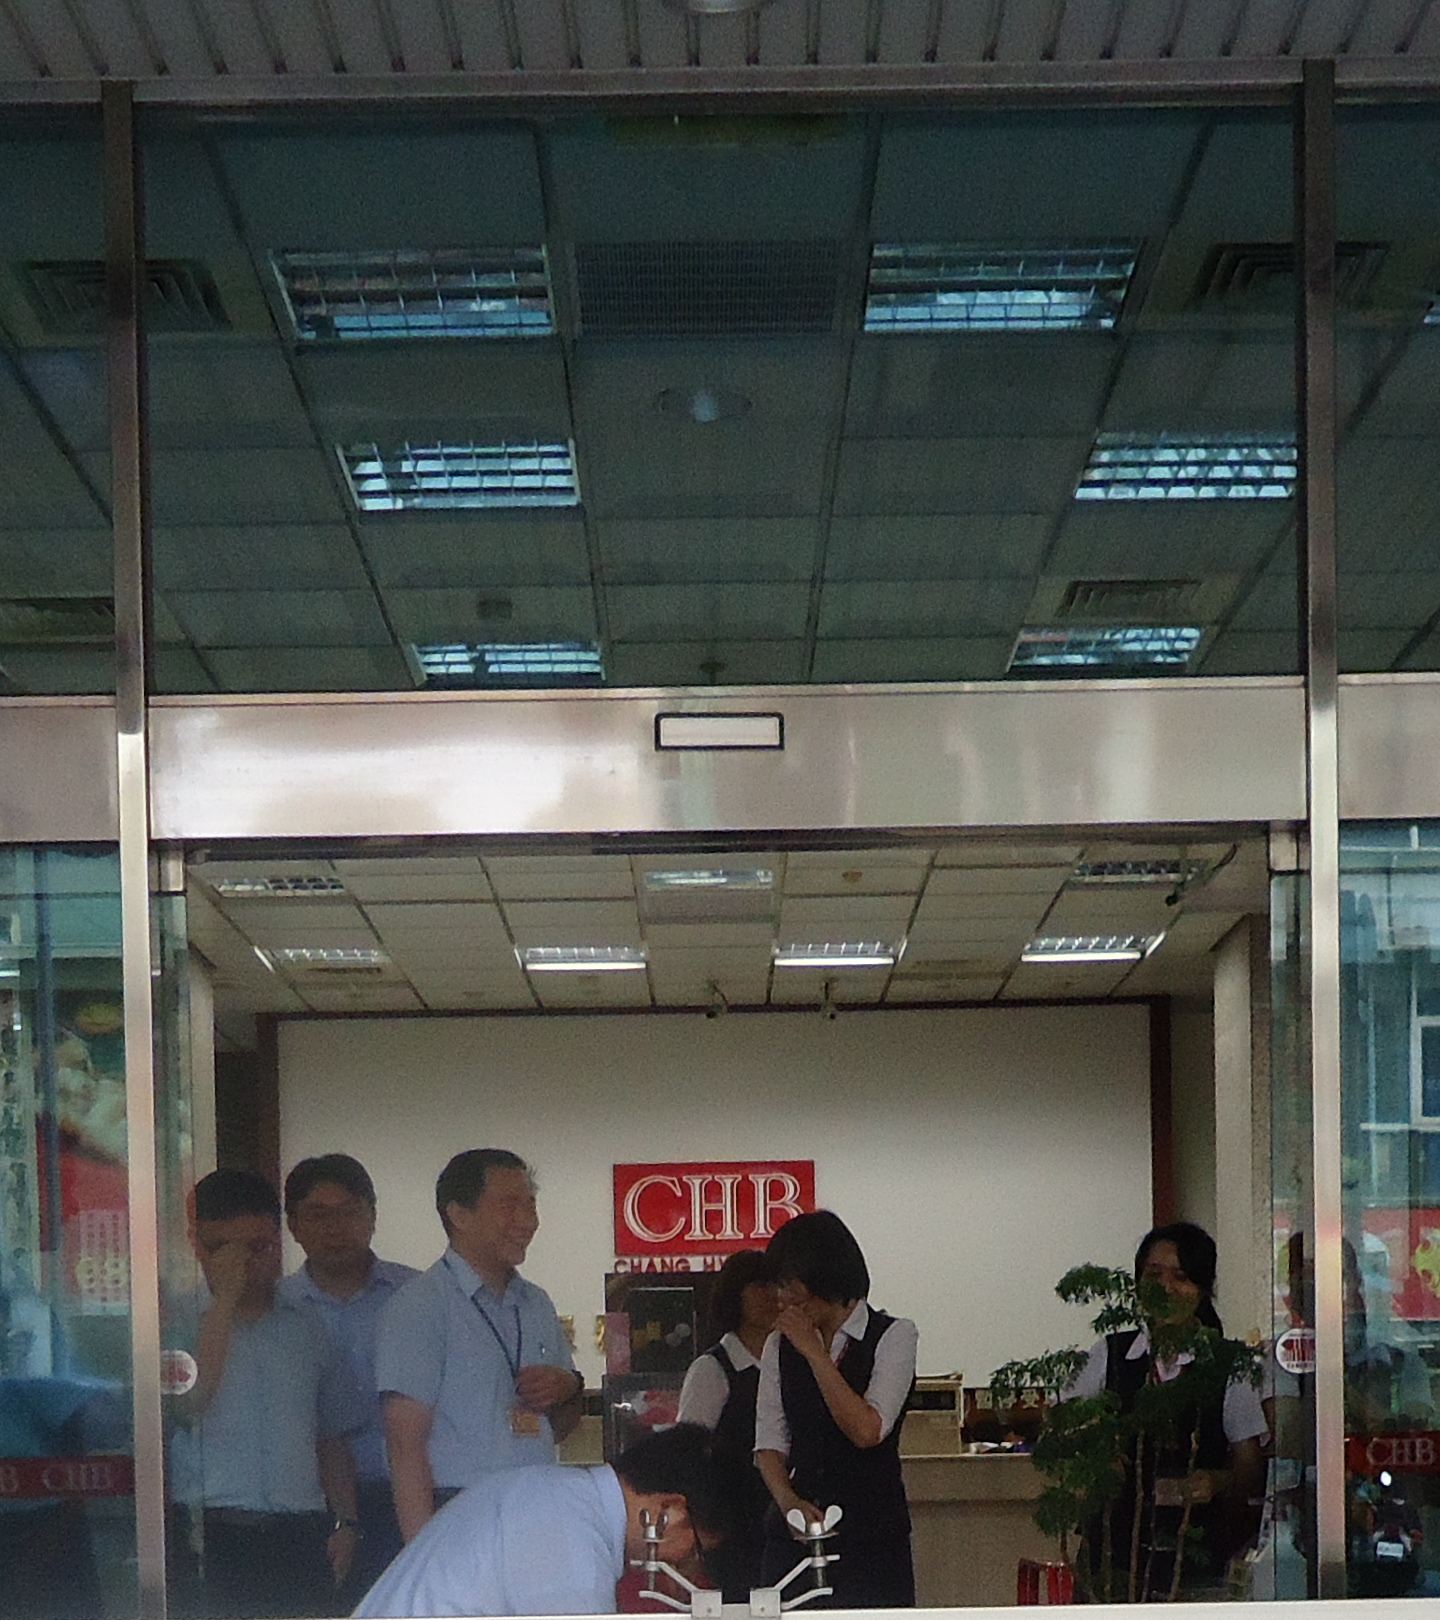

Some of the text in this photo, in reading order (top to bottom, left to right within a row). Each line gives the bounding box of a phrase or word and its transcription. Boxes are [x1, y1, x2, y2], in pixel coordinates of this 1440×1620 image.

[622, 1172, 806, 1243] CHB
[613, 1257, 691, 1274] CHANG
[1366, 1436, 1436, 1466] CHB
